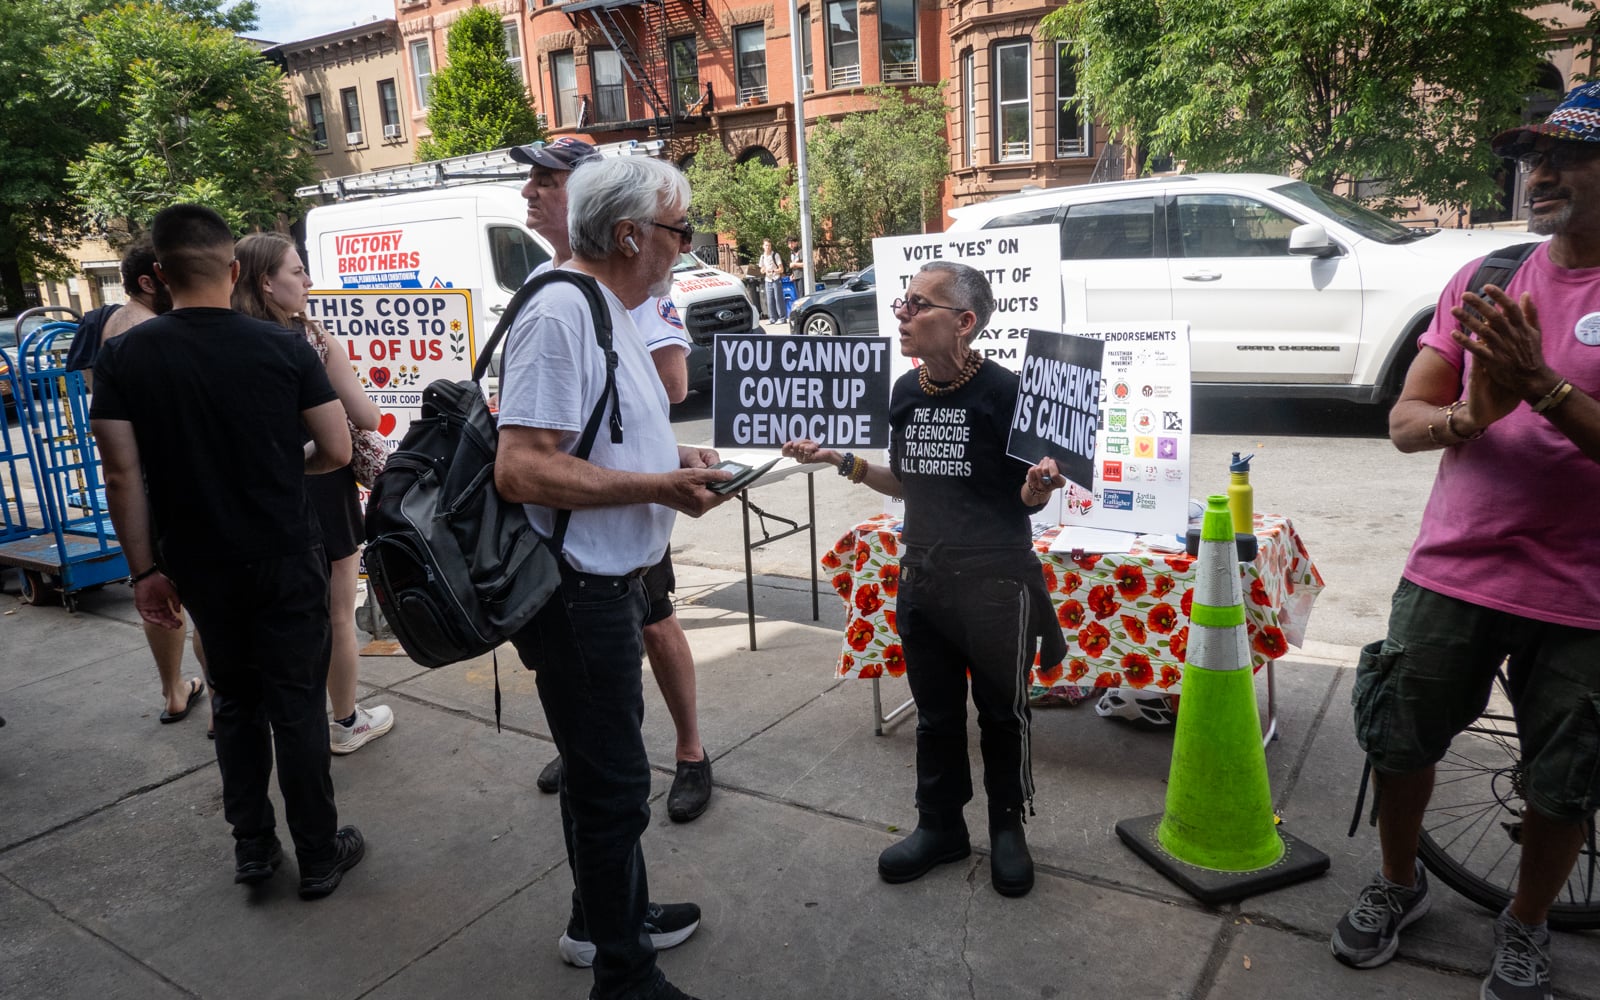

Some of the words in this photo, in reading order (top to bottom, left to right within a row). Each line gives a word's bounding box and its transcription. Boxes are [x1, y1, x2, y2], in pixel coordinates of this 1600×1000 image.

[336, 230, 402, 255] VICTORY
[904, 244, 942, 261] VOTE
[998, 238, 1018, 254] ON
[338, 252, 420, 273] BROTHERS
[1012, 267, 1032, 282] OF
[308, 298, 364, 317] THIS
[376, 298, 446, 317] COOP
[326, 319, 410, 336] ELONGS
[418, 319, 446, 336] TO
[978, 329, 1003, 340] AY
[1105, 331, 1176, 341] ENDORSEMENTS
[370, 340, 401, 361] OF
[410, 340, 443, 361] US
[722, 340, 772, 372] YOU
[781, 341, 886, 372] CANNOT
[984, 348, 1017, 359] PM
[740, 377, 824, 408] COVER
[832, 378, 866, 409] UP
[1022, 354, 1101, 416] CONSCIENCE
[381, 395, 397, 404] OUR
[400, 395, 420, 404] COOP
[914, 408, 930, 422] THE
[932, 408, 966, 424] ASHES
[732, 413, 871, 445] GENOCIDE
[905, 425, 917, 440] OF
[918, 425, 970, 442] GENOCIDE
[1013, 394, 1034, 432] IS
[1036, 399, 1096, 460] CALLING
[906, 442, 965, 459] TRANSCEND
[902, 458, 916, 474] ALL
[919, 460, 972, 476] BORDERS
